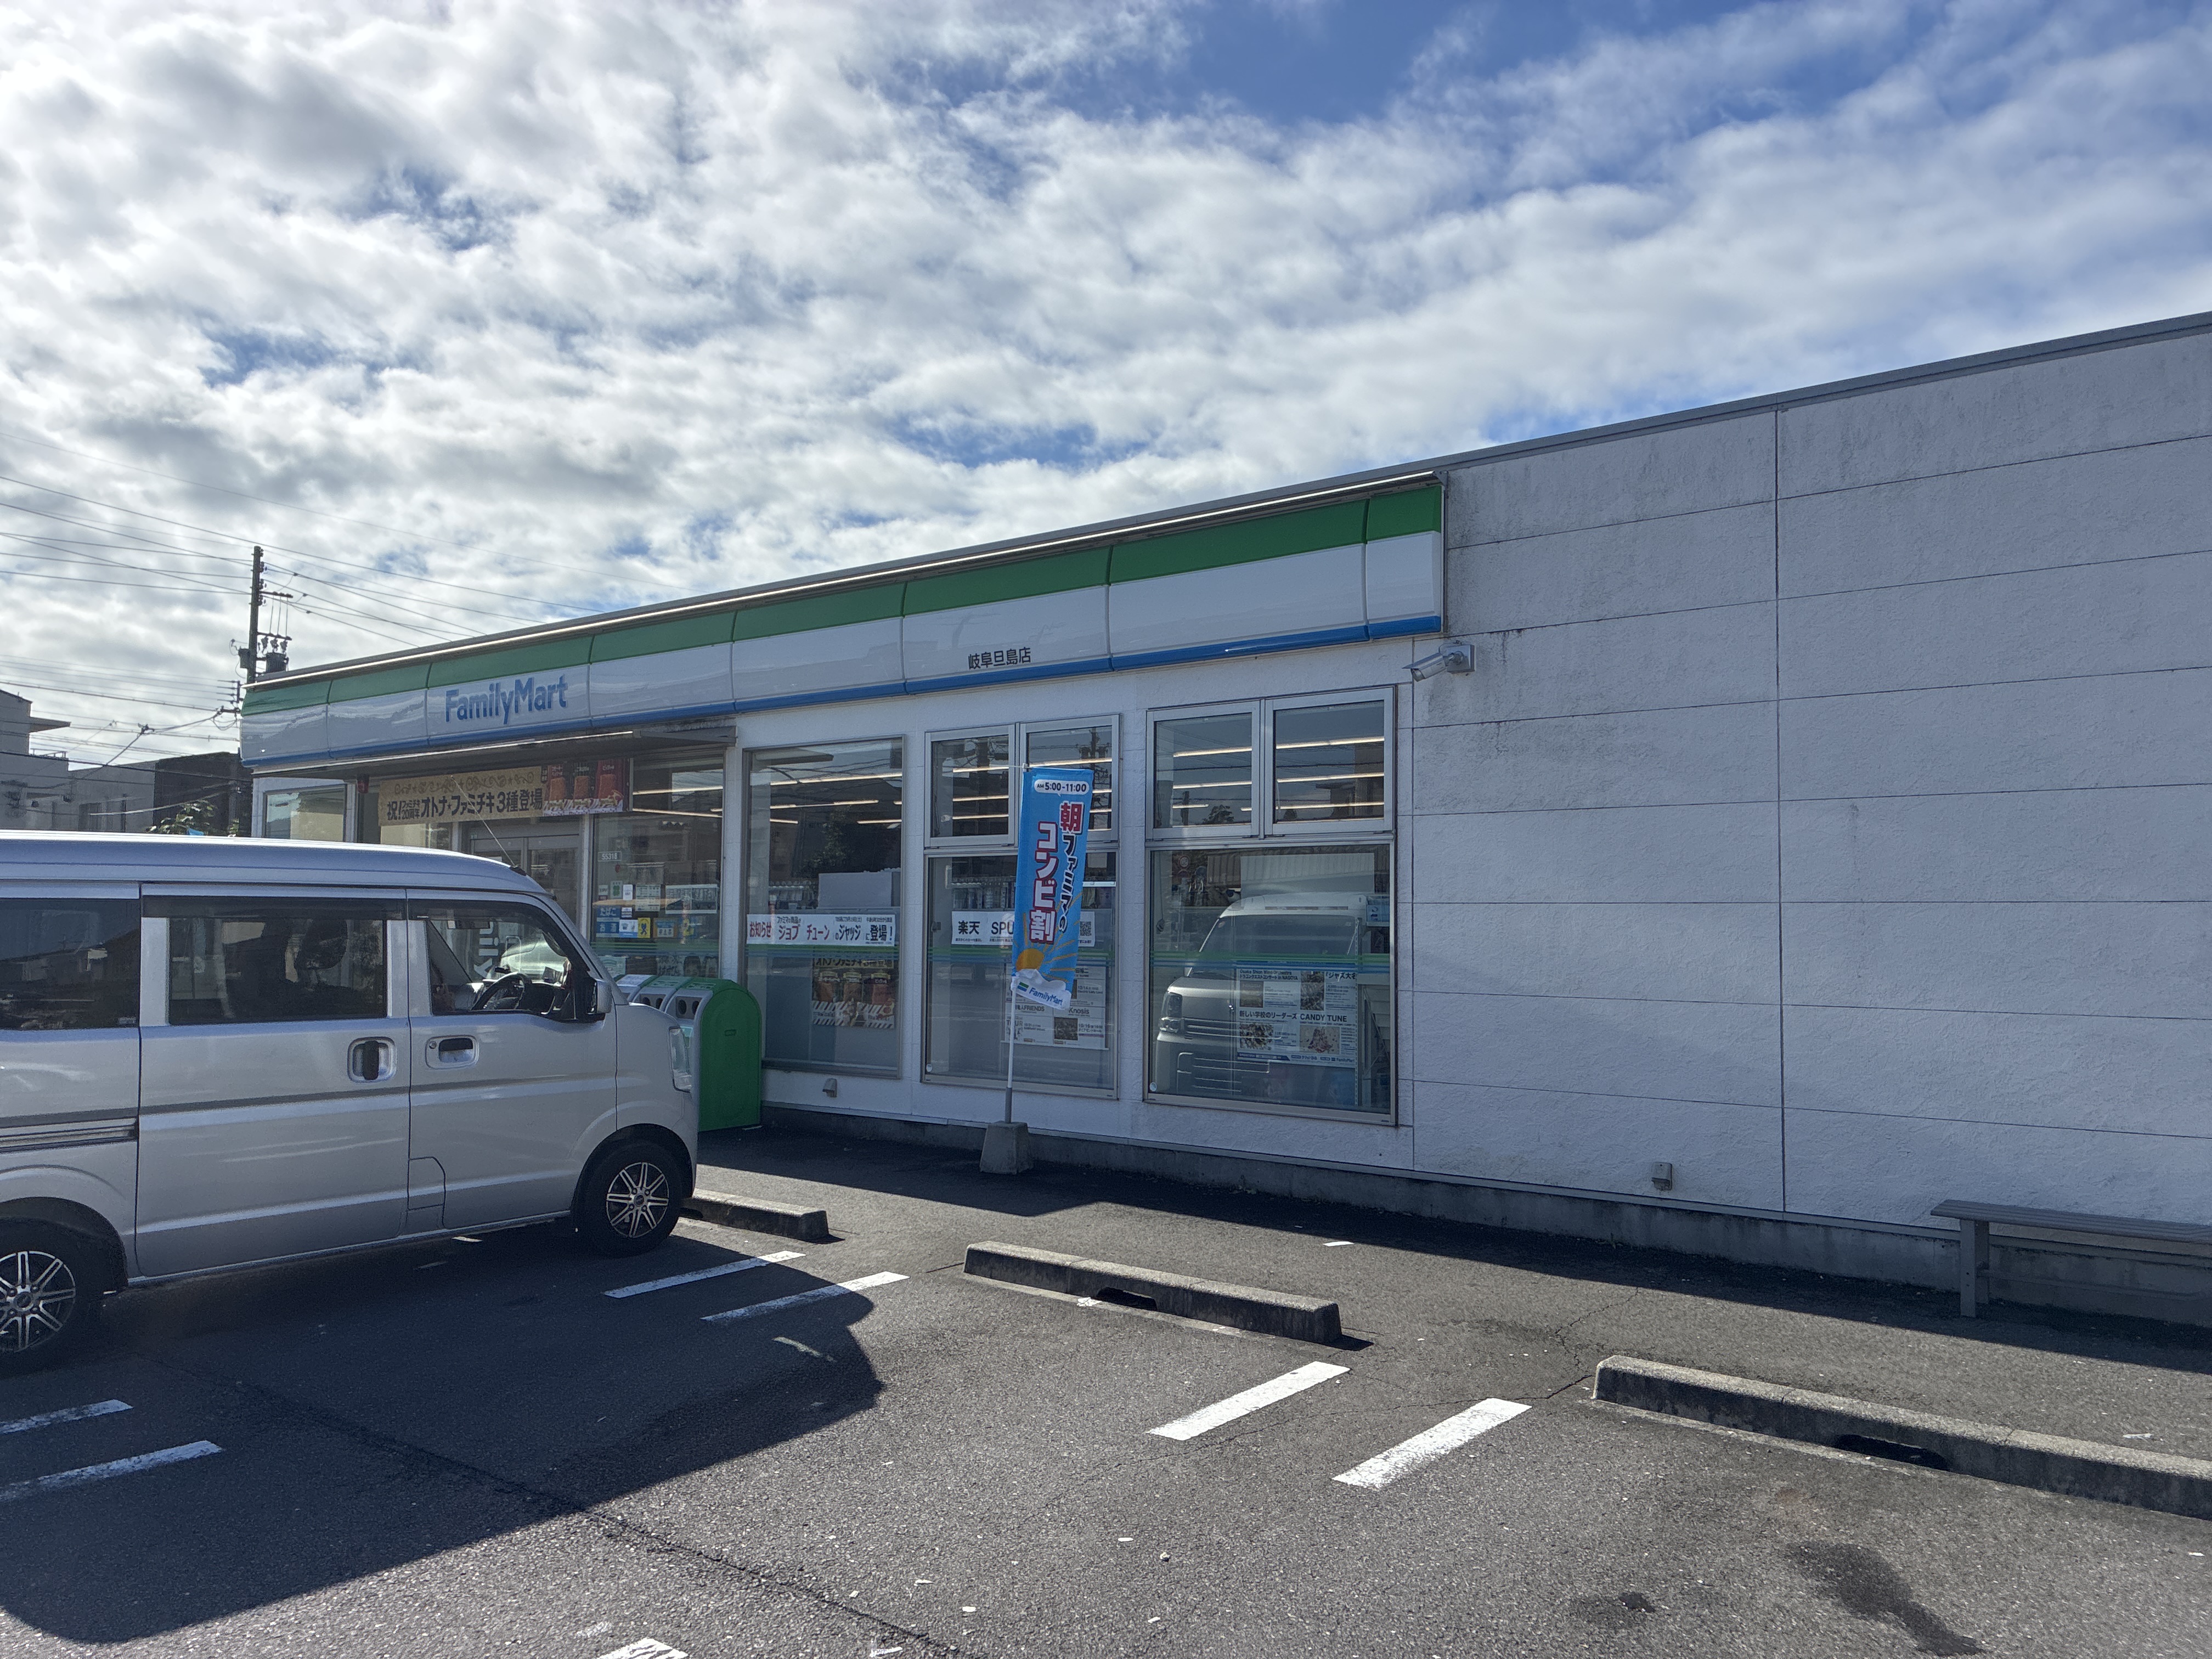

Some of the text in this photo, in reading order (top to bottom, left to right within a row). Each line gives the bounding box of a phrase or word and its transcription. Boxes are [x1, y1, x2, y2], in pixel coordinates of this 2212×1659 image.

[968, 647, 1031, 670] 岐阜旦島店
[445, 674, 568, 725] FamilyMart
[1058, 800, 1085, 933] 朝ファミマの
[1029, 821, 1059, 944] コンビ割
[749, 921, 772, 938] お知らせ
[958, 921, 980, 935] 楽天
[1029, 987, 1063, 1006] FamilyMart
[1239, 1010, 1297, 1020] 新しい学校のリーダーズ
